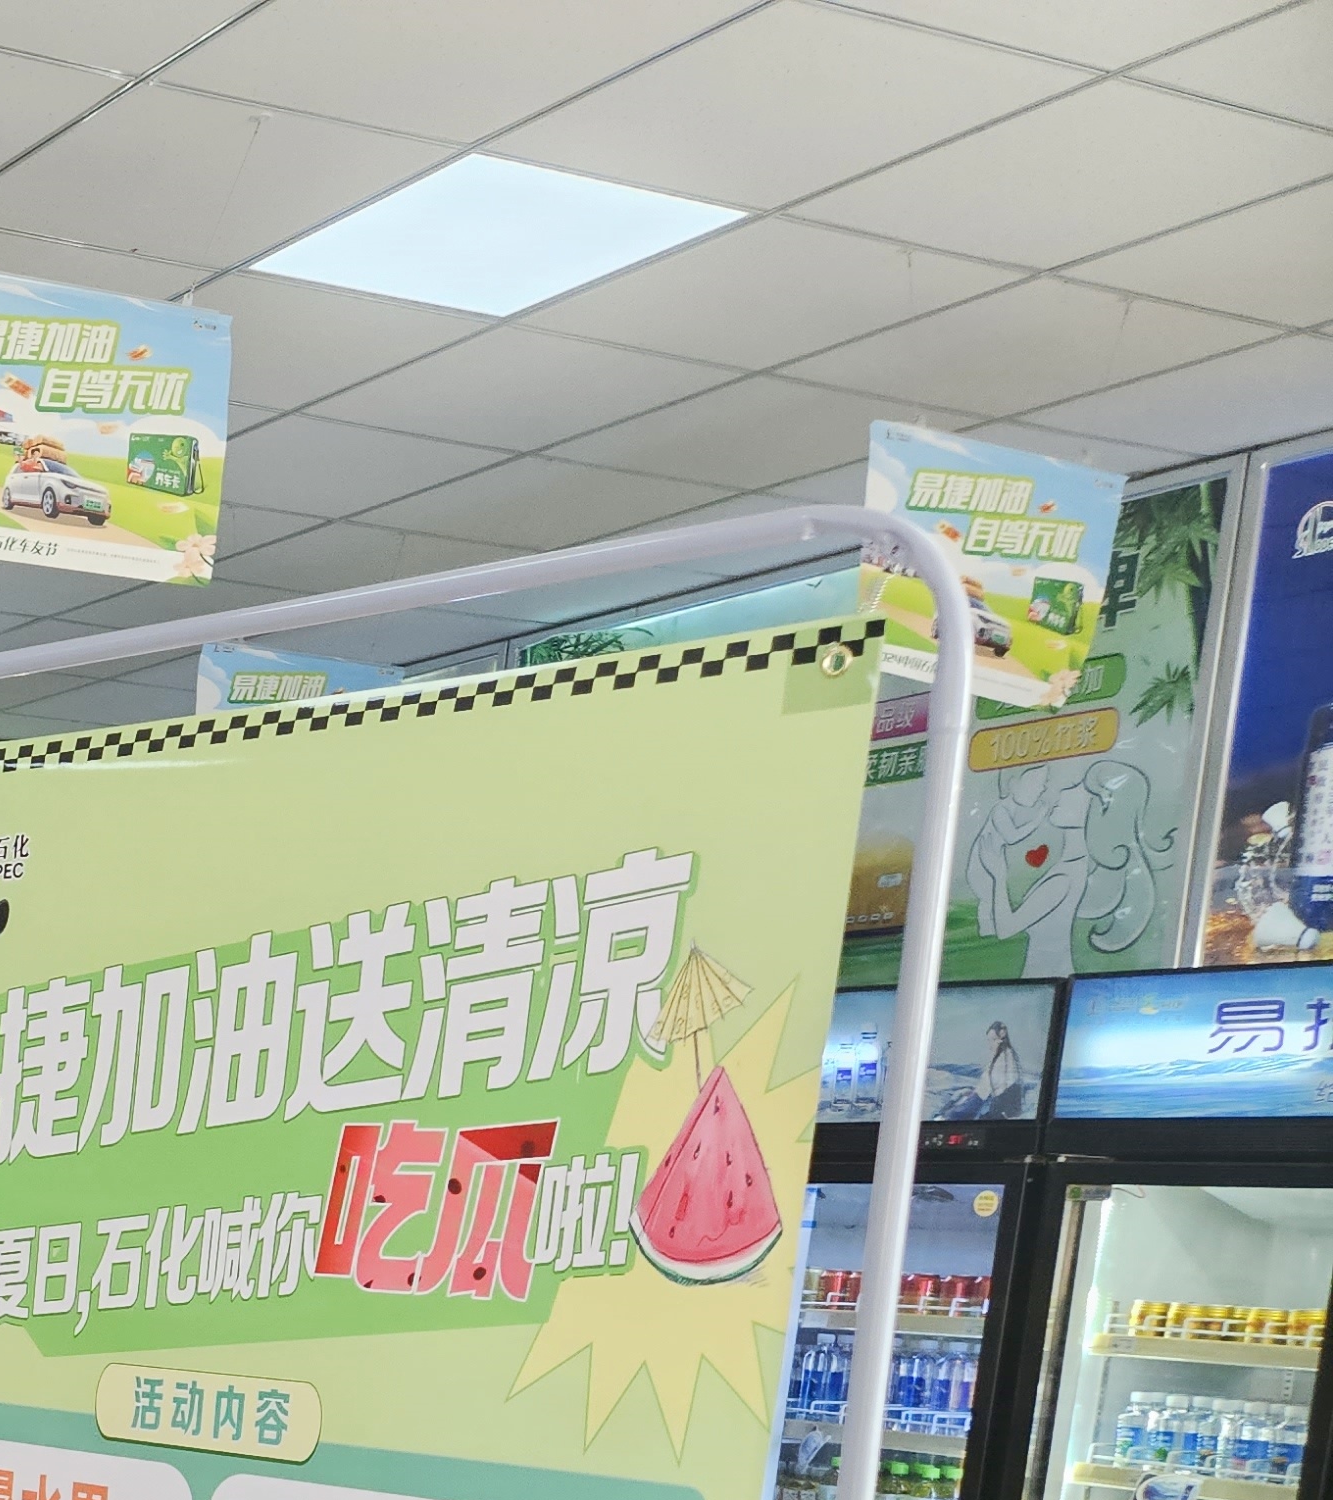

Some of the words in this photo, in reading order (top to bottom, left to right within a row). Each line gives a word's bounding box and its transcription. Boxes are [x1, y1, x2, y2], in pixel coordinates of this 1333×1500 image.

[38, 368, 189, 412] 自驾无忧
[910, 472, 1033, 516] 易捷加油
[965, 518, 1084, 559] 自驾无忧
[228, 672, 327, 702] 易捷加油
[131, 1374, 293, 1447] 活动内容
